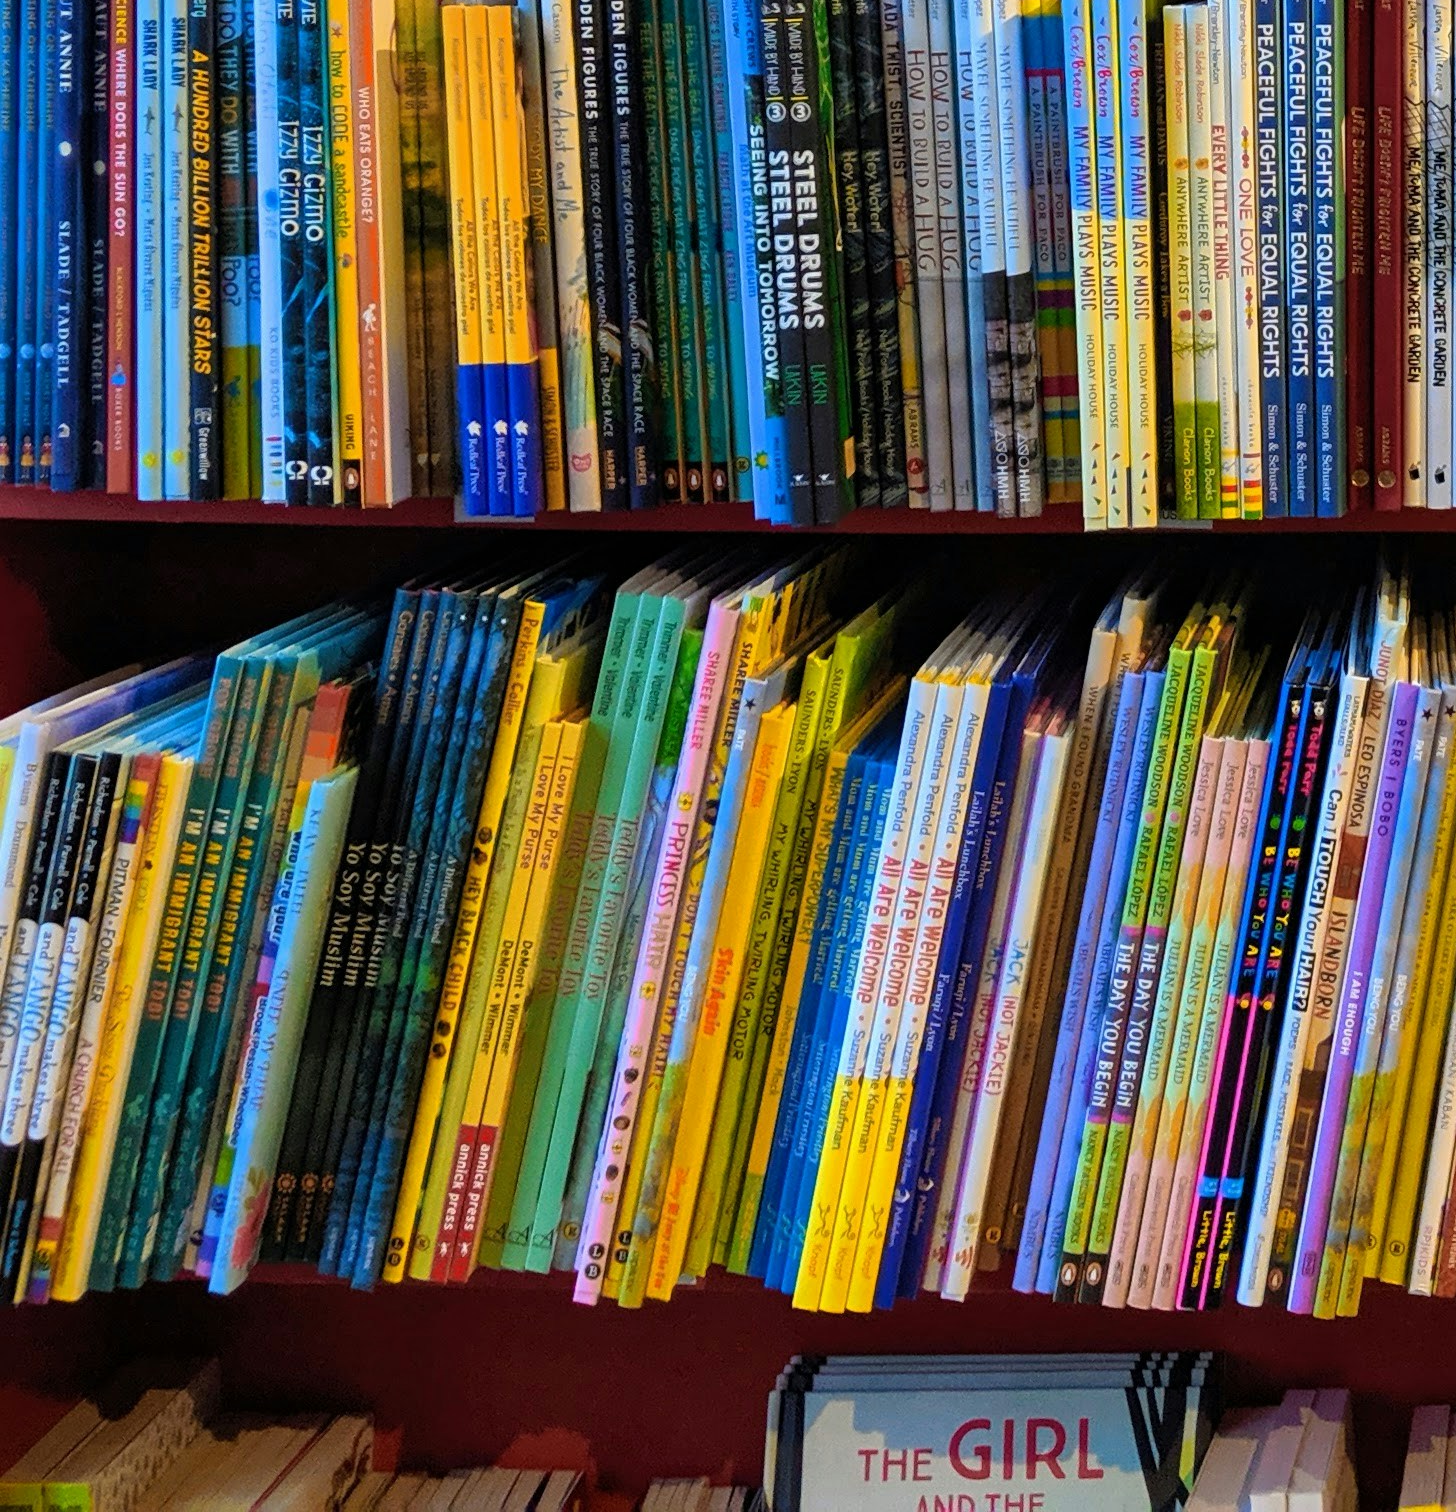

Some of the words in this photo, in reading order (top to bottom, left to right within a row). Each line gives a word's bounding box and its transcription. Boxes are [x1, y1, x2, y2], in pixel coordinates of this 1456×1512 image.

[57, 29, 73, 94] ANNIE
[113, 49, 128, 93] WHERE
[192, 50, 208, 64] A
[612, 42, 631, 116] FIGURES
[1313, 23, 1334, 123] PEACEFUL
[113, 98, 128, 134] DOES
[191, 68, 210, 151] HUNDRED
[357, 87, 371, 118] WHO
[113, 138, 127, 167] THE
[357, 122, 372, 155] EATS
[1128, 135, 1145, 158] MY
[113, 171, 127, 201] SUN
[1314, 127, 1334, 198] FIGHTS
[191, 157, 210, 226] BILLION
[358, 159, 374, 223] ORANGE?
[792, 149, 816, 227] STEEL
[1129, 164, 1147, 219] FAMILY
[113, 206, 127, 237] GO?
[1315, 203, 1335, 227] for
[192, 230, 211, 311] TRILLION
[1131, 224, 1149, 271] PLAYS
[1314, 233, 1334, 300] EQUAL
[797, 234, 824, 330] DRUMS
[1131, 275, 1150, 320] MUSIC
[194, 316, 217, 374] STARS
[1315, 304, 1335, 378] RIGHTS
[185, 808, 205, 836] I'M
[179, 841, 197, 866] AN
[936, 856, 955, 881] All
[156, 872, 190, 973] IMMIGRANT
[927, 884, 951, 921] Are
[909, 925, 943, 1005] Welcome
[1140, 943, 1159, 974] THE
[1314, 908, 1348, 1020] ISLANDBORN
[1132, 978, 1152, 1012] DAY
[1125, 1018, 1145, 1054] YOU
[1114, 1061, 1136, 1108] BEGIN
[858, 1448, 933, 1481] THE
[949, 1418, 1104, 1480] GIRL
[917, 1494, 975, 1512] AND
[985, 1493, 1045, 1512] THE
